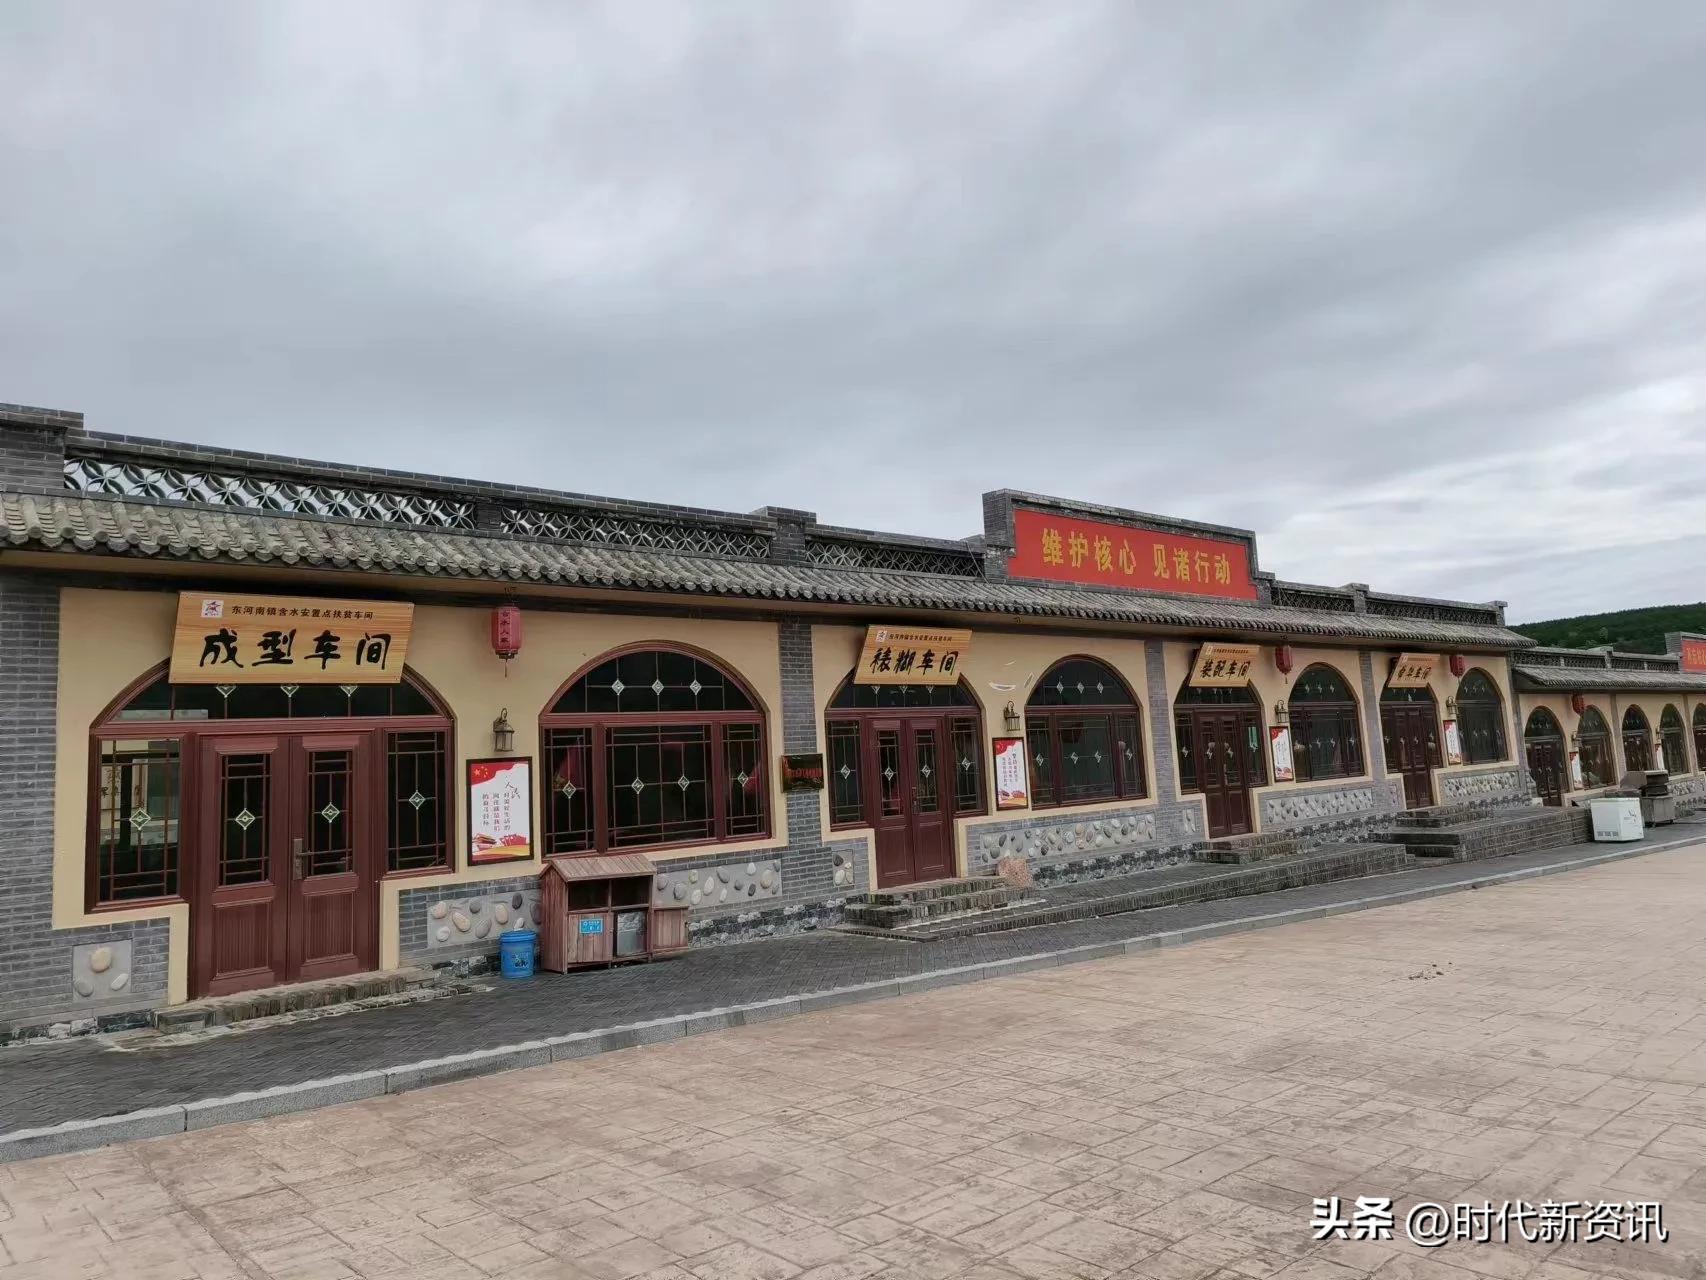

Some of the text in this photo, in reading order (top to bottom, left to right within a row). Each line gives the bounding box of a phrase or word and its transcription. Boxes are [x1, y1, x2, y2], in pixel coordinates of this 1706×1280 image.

[1041, 527, 1232, 585] 维护核心 见诸行动
[231, 604, 374, 621] 东河南镇含水安置点扶贫车间
[199, 628, 392, 671] 成型车间
[869, 646, 959, 676] 裱糊车间
